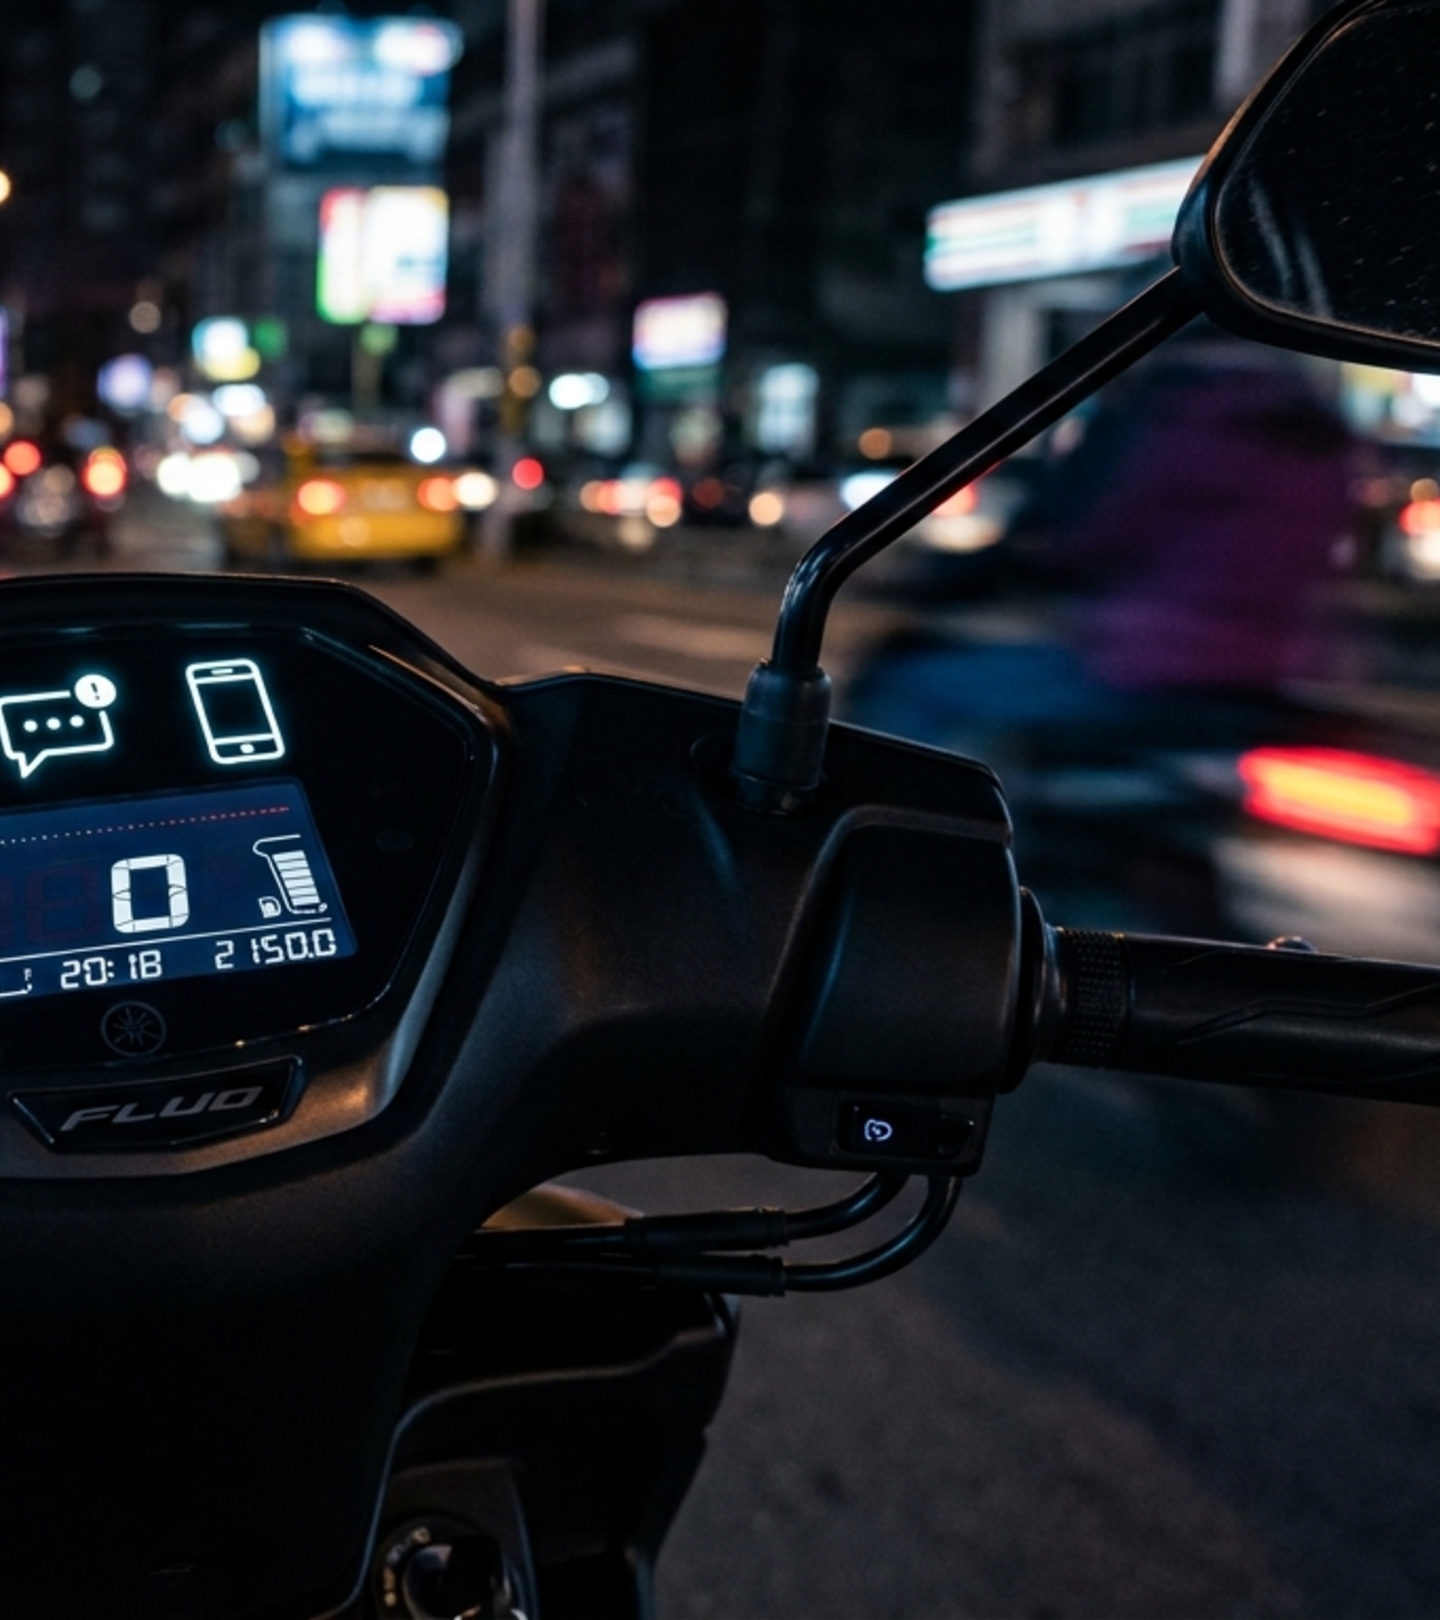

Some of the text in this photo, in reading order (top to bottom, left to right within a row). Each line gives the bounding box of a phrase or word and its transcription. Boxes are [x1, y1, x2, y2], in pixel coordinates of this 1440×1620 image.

[110, 854, 190, 933] 0
[60, 950, 162, 989] 20:18
[59, 1086, 263, 1131] FLUO
